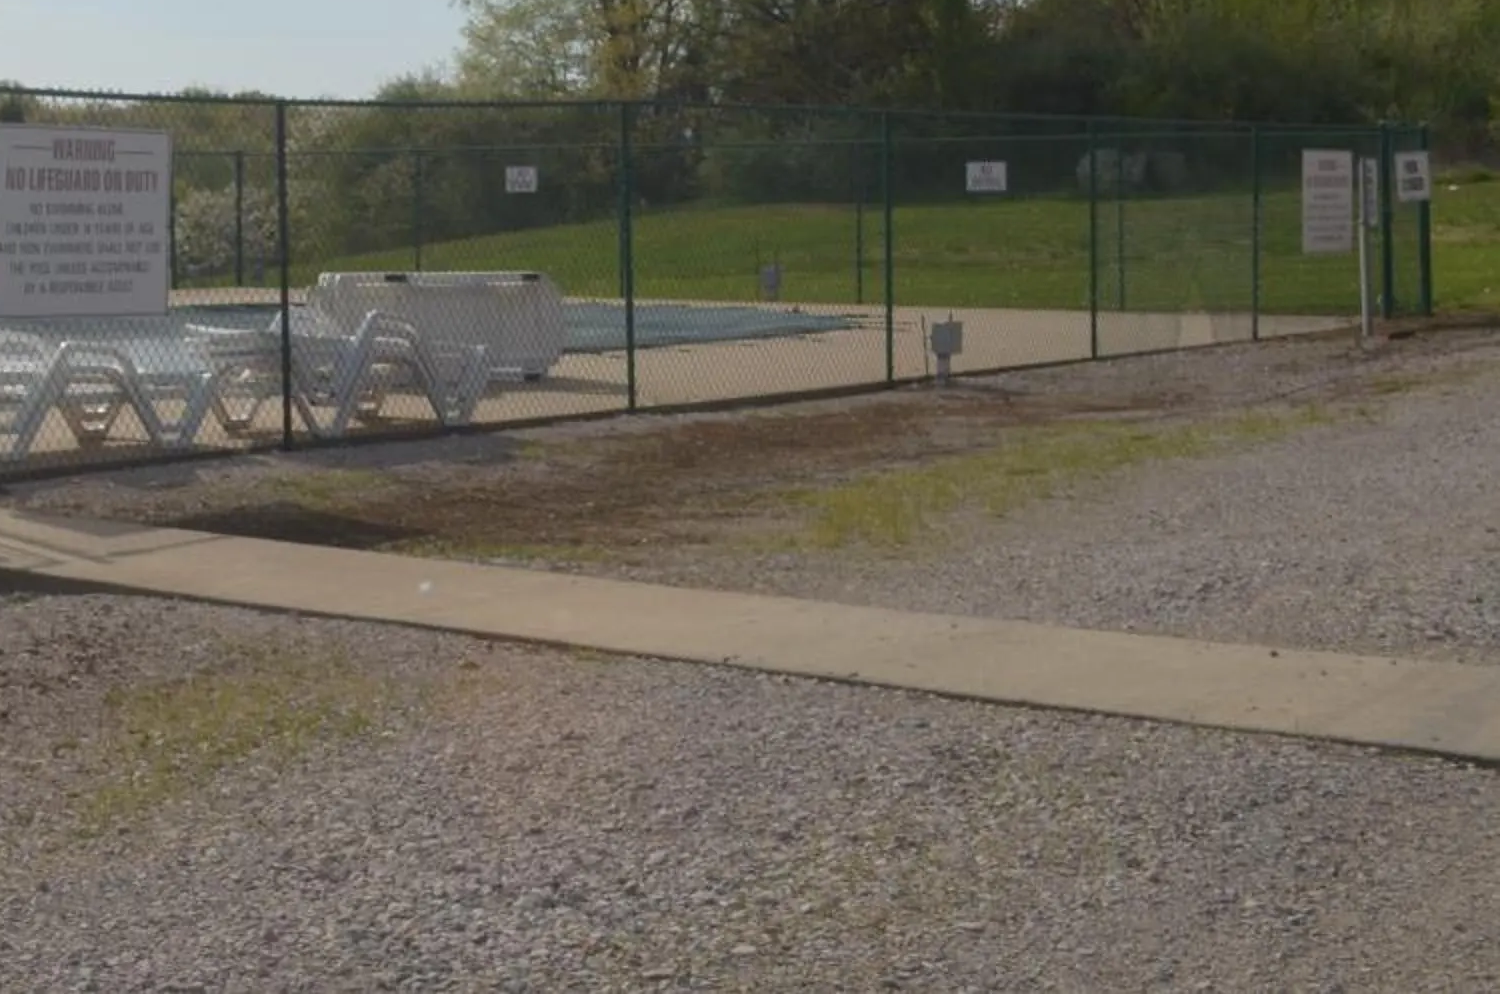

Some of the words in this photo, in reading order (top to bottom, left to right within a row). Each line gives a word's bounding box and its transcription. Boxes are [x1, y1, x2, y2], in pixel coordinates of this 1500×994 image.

[52, 138, 116, 161] WARNING
[5, 168, 26, 191] NO
[29, 168, 101, 191] LIFEGUARD
[103, 169, 123, 192] ON
[125, 170, 159, 193] DUTY
